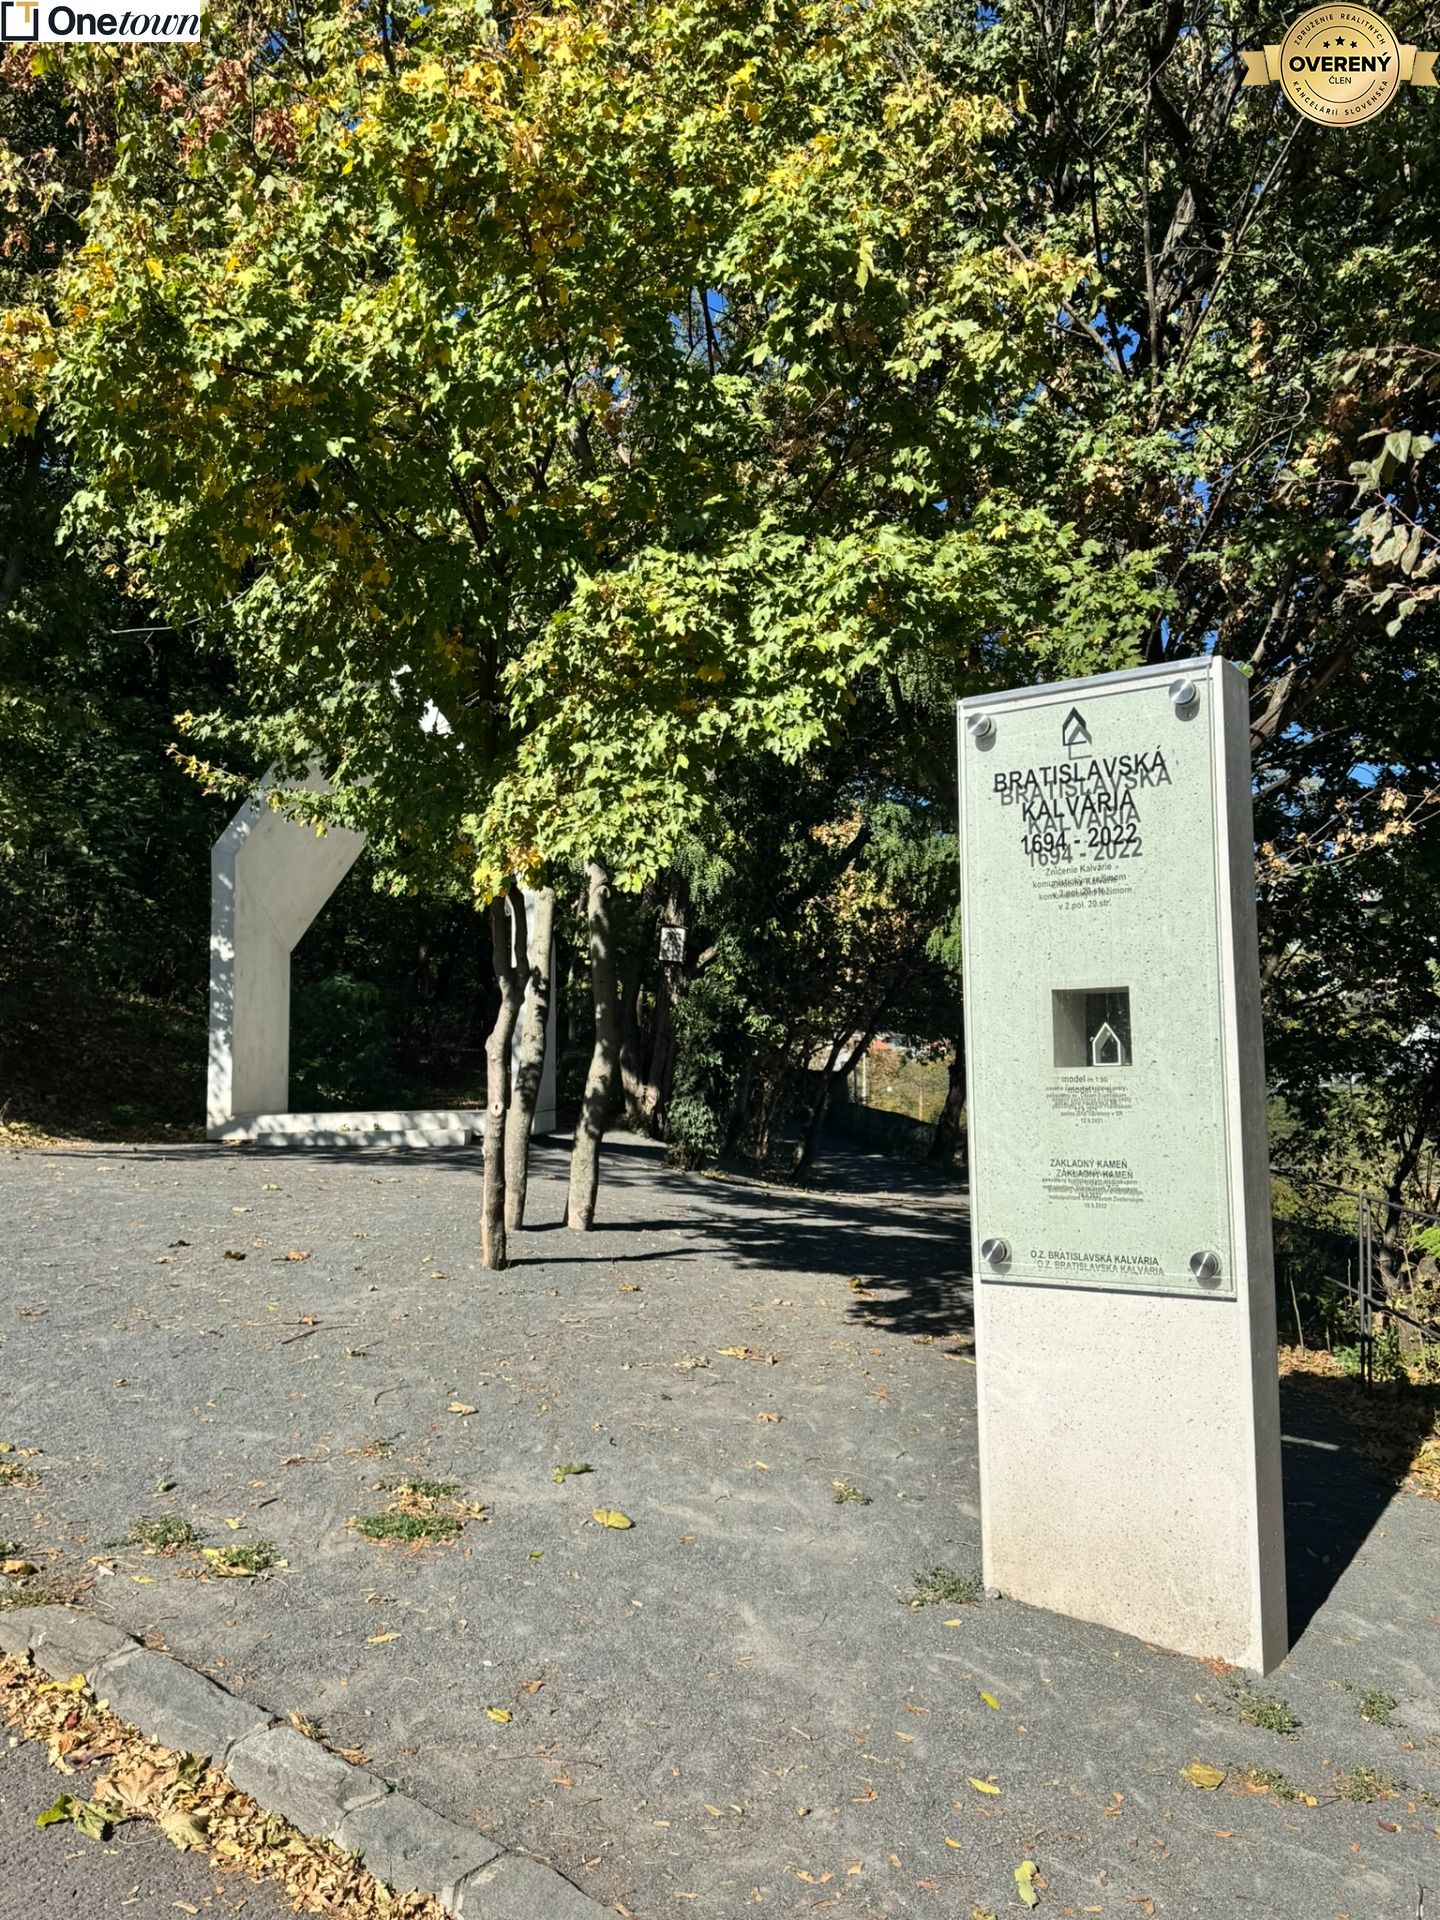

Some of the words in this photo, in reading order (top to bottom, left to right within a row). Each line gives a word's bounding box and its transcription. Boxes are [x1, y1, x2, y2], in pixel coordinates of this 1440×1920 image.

[994, 745, 1166, 793] BRATISLAVSKÁ
[1021, 831, 1067, 855] 1694
[1088, 823, 1137, 848] 2022
[1048, 1250, 1112, 1263] BRATISLAVSKÁ
